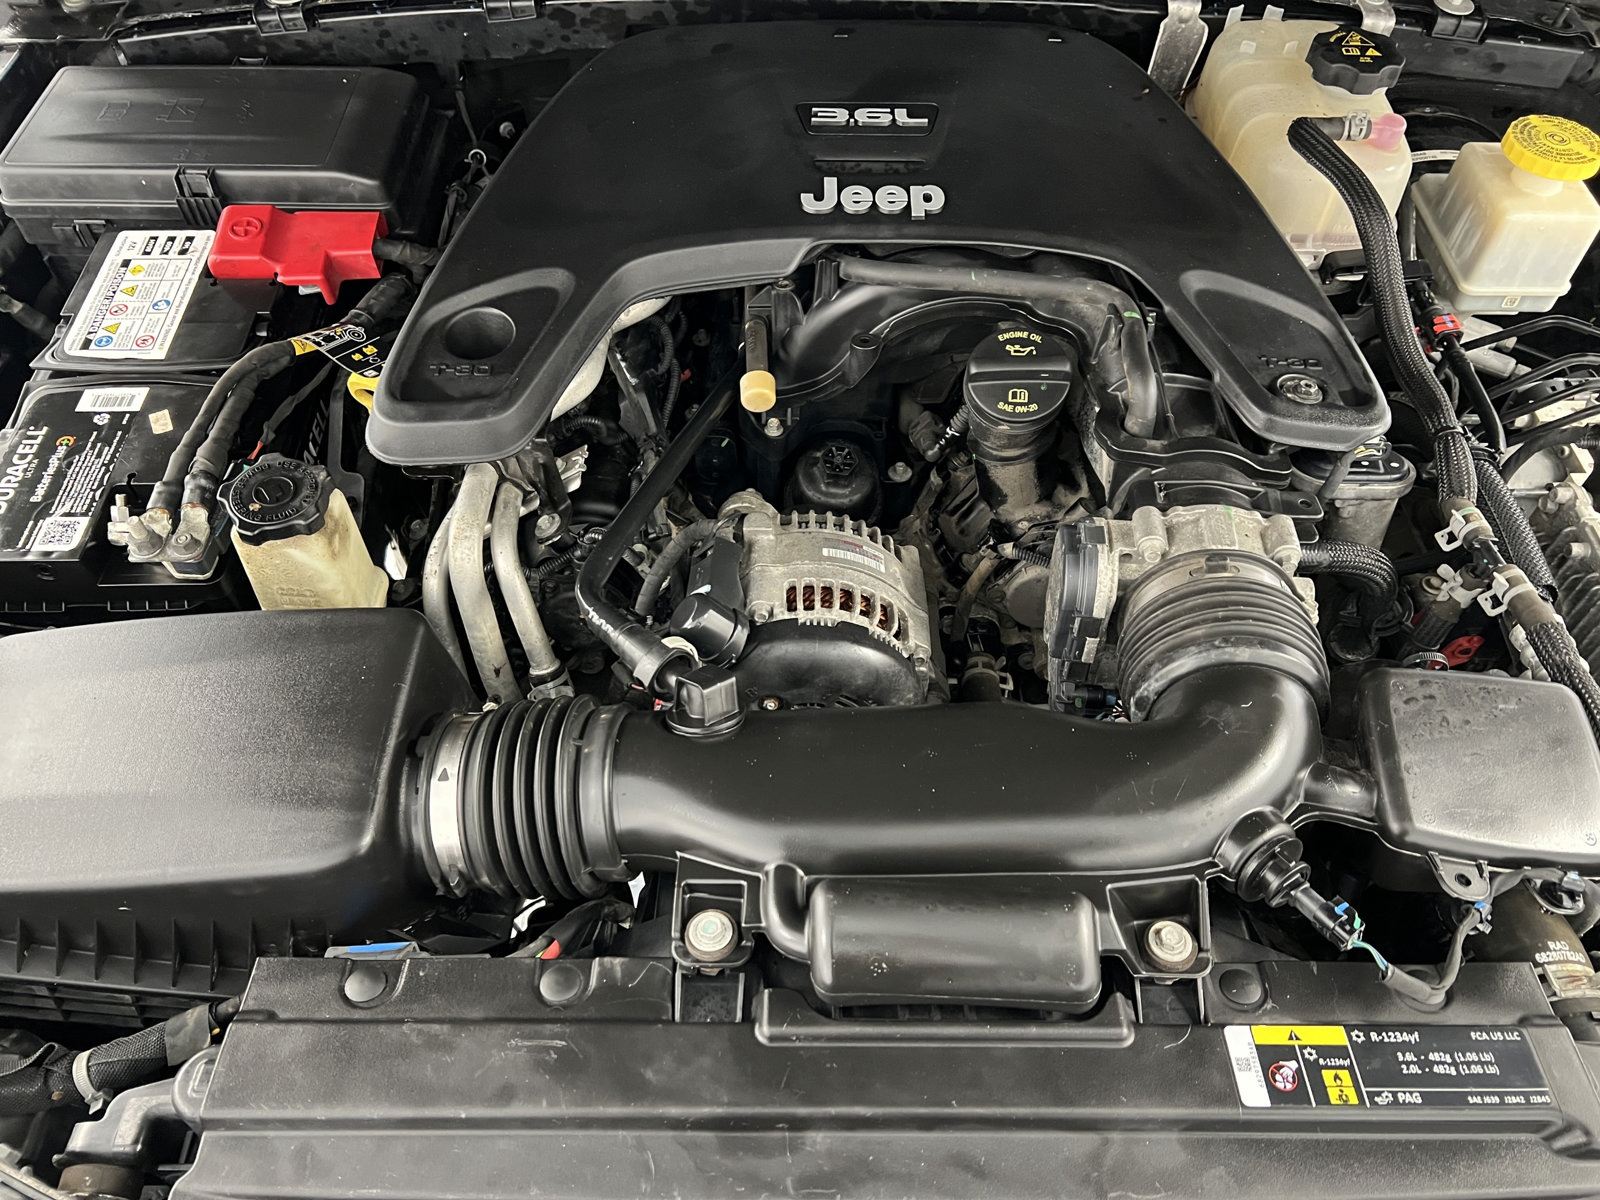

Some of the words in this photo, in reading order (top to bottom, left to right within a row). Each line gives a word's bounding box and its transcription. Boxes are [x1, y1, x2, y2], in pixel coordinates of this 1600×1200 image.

[811, 107, 928, 127] 3.6L
[800, 177, 946, 220] Jeep
[998, 331, 1029, 342] ENGINE
[1029, 333, 1042, 344] OIL
[997, 402, 1015, 412] SAE
[1015, 403, 1038, 413] 0W-20
[24, 458, 39, 479] ULTRA
[232, 490, 262, 521] STEERING
[265, 507, 298, 521] FLUID
[1547, 940, 1569, 950] RAD
[1370, 1031, 1420, 1045] R-1234yf
[1470, 1031, 1490, 1041] FCA
[1490, 1031, 1503, 1041] US
[1504, 1031, 1522, 1041] LLC
[1428, 1052, 1452, 1063] 482g
[1454, 1051, 1479, 1063] (1.06
[1401, 1064, 1422, 1074] 2.0L
[1433, 1064, 1457, 1076] 482g
[1459, 1063, 1483, 1076] (1.06
[1398, 1092, 1422, 1104] PAG
[1468, 1095, 1483, 1104] SAE
